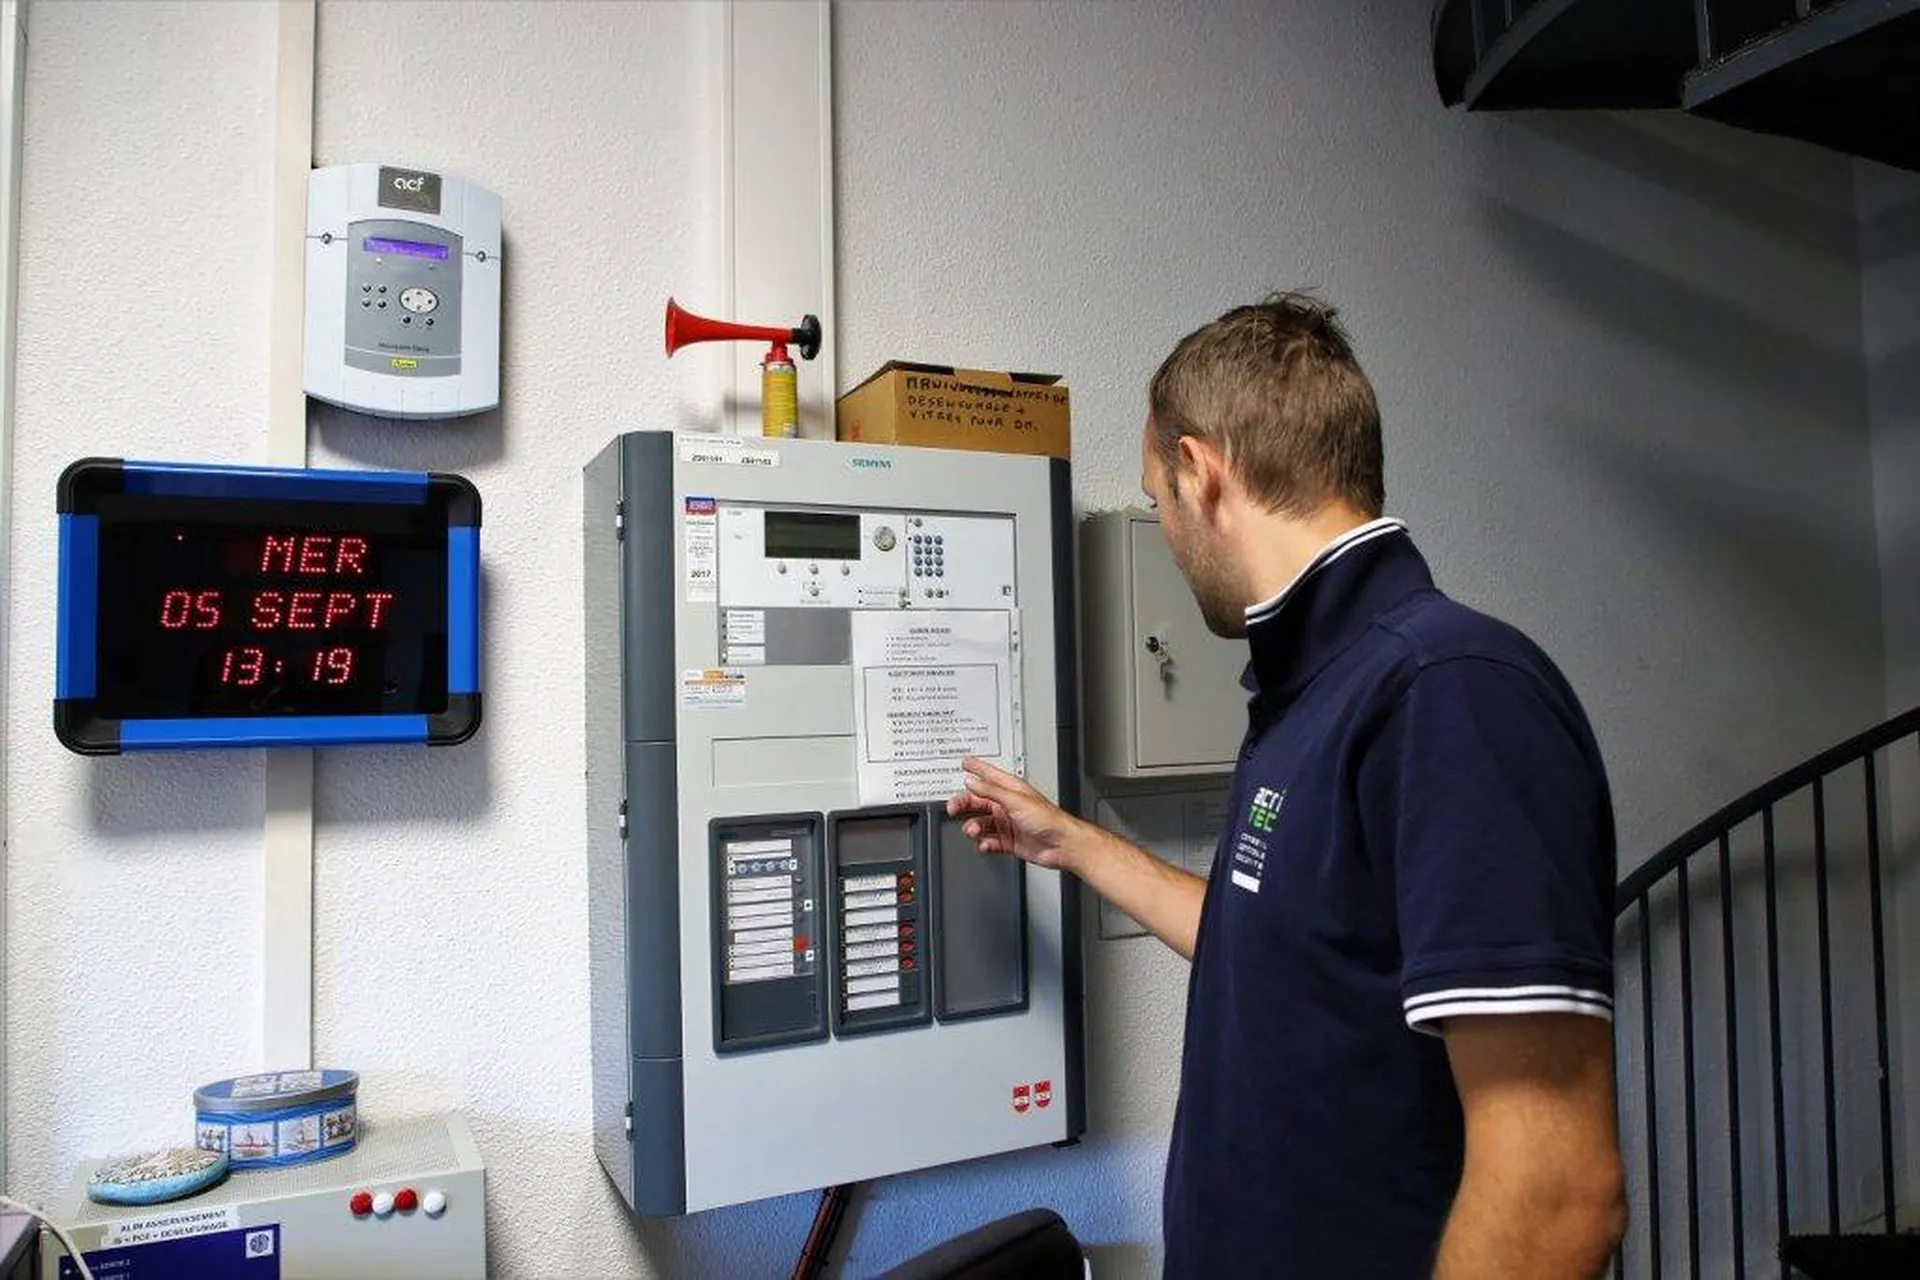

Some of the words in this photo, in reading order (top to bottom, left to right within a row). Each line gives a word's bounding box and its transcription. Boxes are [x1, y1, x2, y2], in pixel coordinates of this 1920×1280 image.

[261, 536, 367, 573] MER
[161, 591, 220, 628] 05
[251, 592, 393, 628] SEPT
[1249, 805, 1277, 832] TEC
